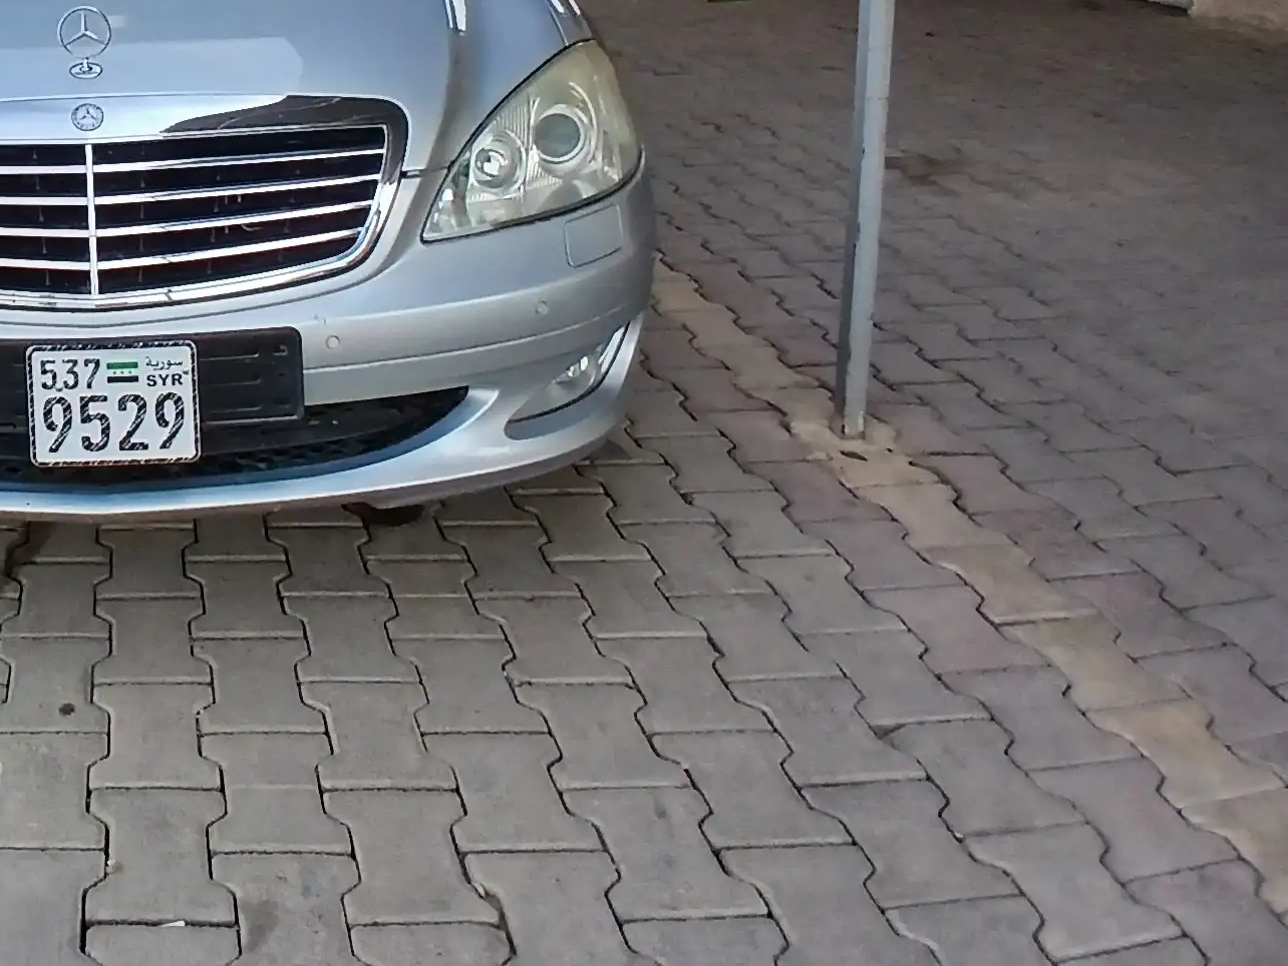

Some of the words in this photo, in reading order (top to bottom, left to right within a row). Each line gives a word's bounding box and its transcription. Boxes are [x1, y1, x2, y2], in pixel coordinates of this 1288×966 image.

[40, 358, 100, 391] 537
[145, 356, 184, 371] سورية
[146, 374, 183, 387] SYR
[43, 392, 185, 453] 9529
